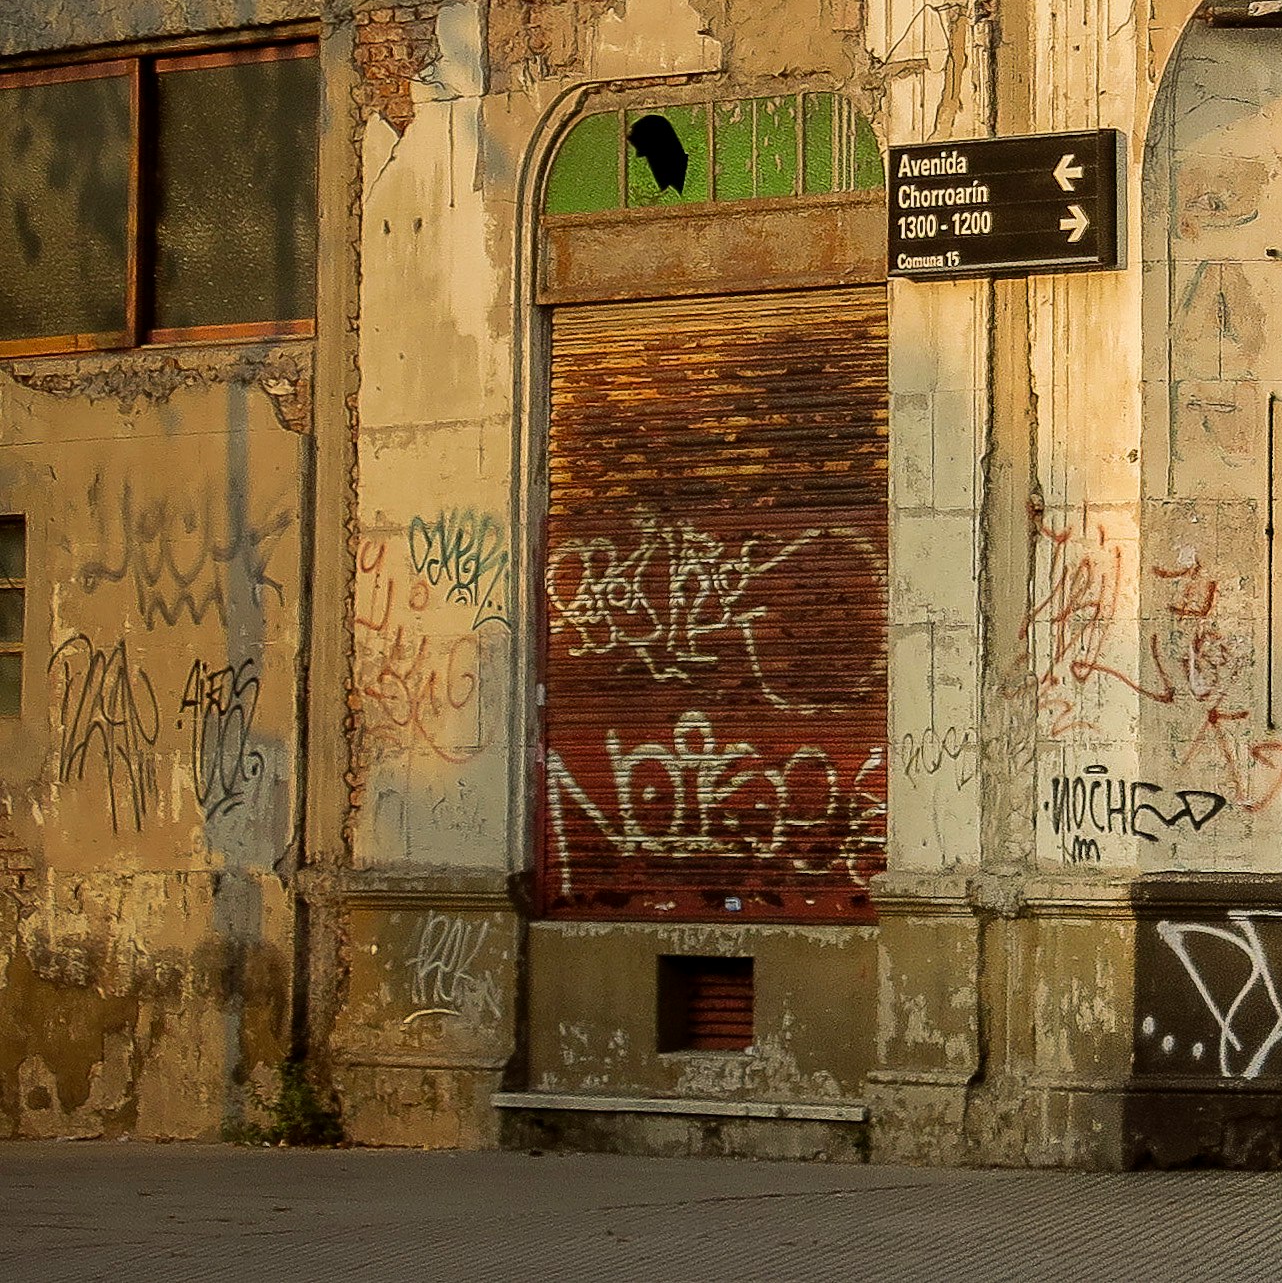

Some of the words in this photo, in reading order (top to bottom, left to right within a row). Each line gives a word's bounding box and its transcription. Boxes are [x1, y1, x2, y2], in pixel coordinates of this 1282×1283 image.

[897, 150, 968, 178] Avenida
[897, 179, 989, 209] Chorroarín
[897, 213, 937, 239] 1300
[951, 210, 992, 236] 1200
[896, 253, 944, 269] Comuna
[945, 251, 960, 267] 15
